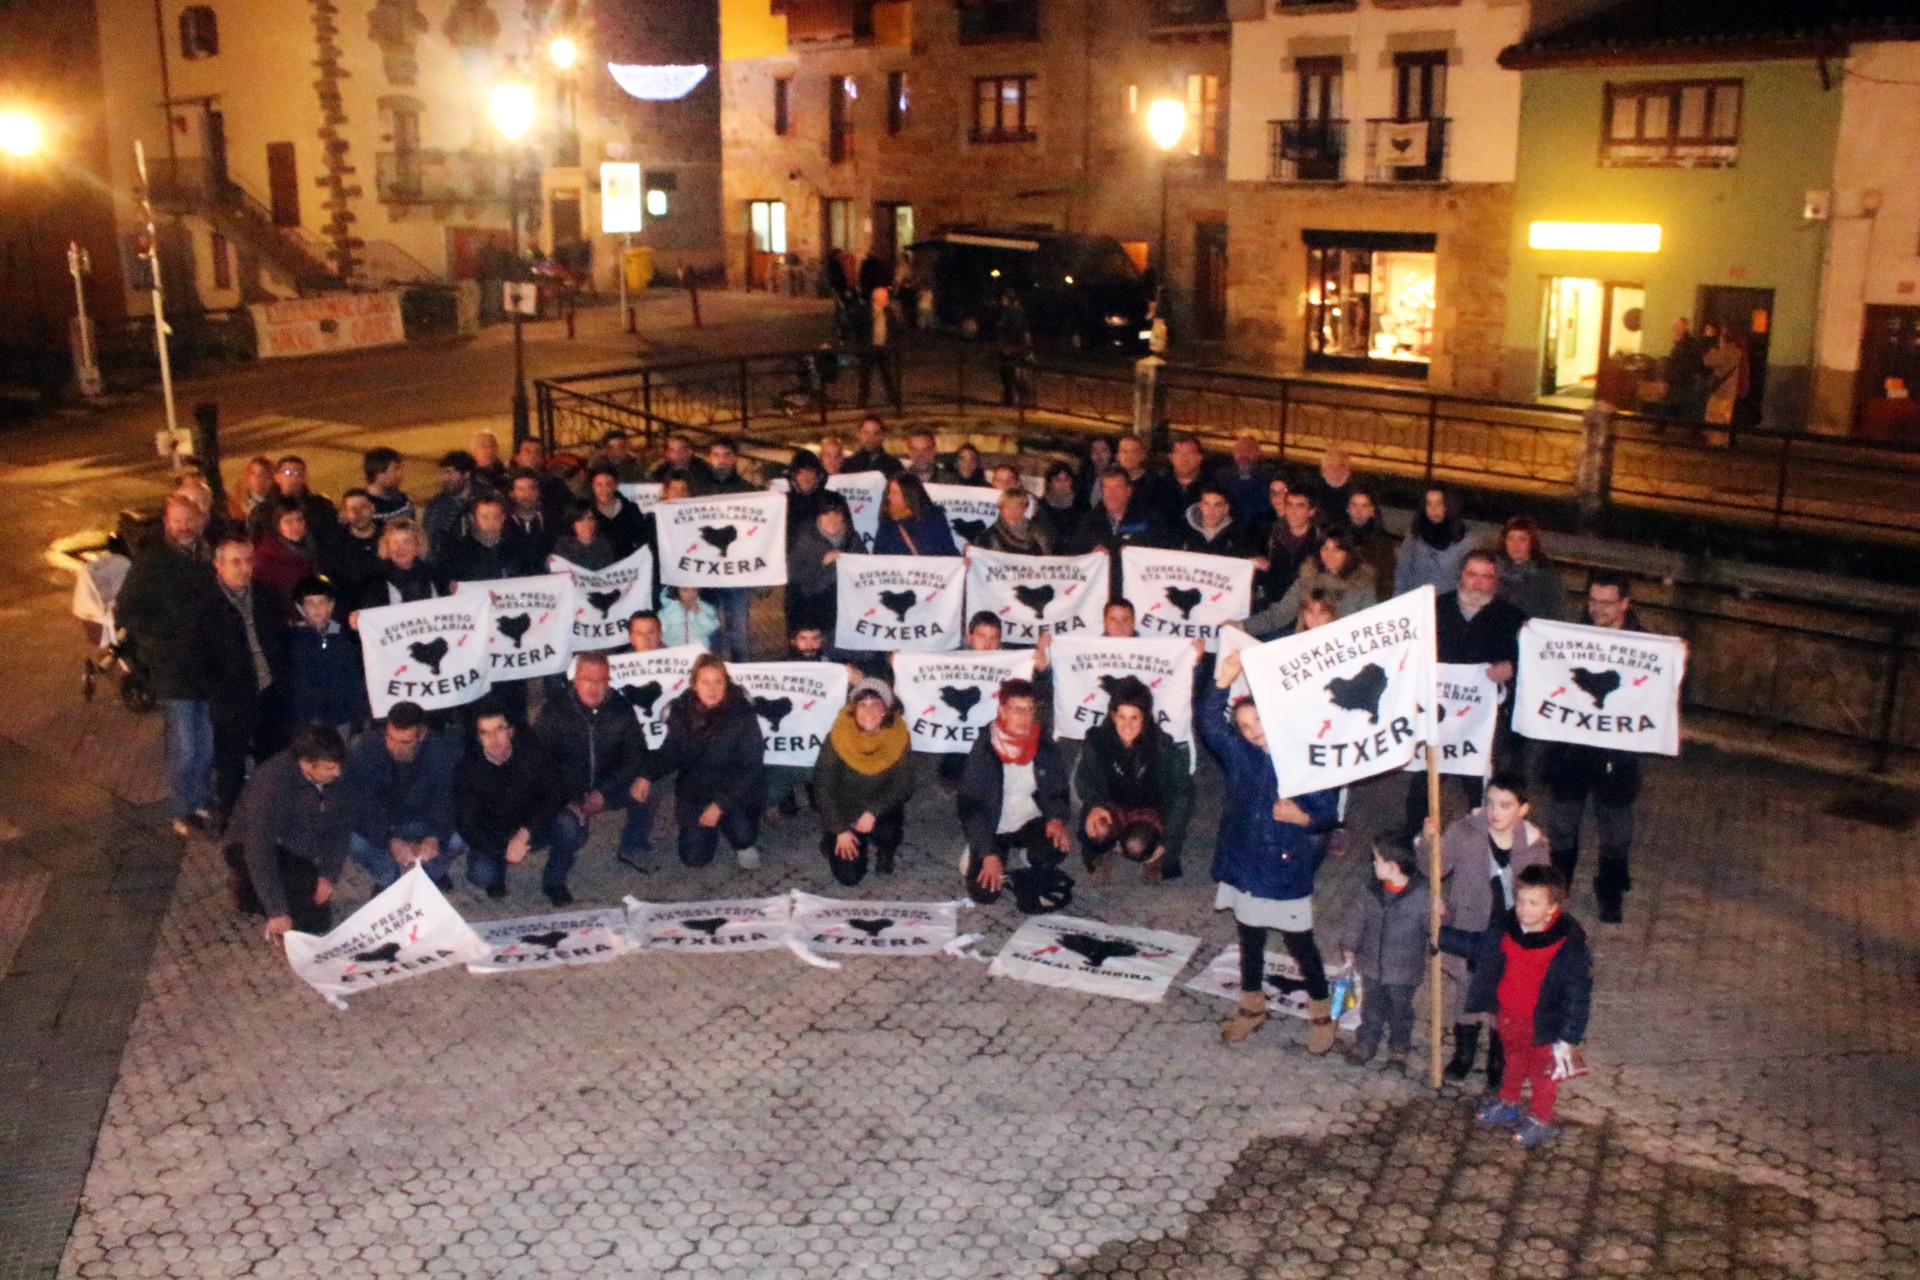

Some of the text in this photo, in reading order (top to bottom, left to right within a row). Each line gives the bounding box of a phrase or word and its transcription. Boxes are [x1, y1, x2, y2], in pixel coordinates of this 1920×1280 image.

[674, 515, 694, 524] ETA
[678, 505, 763, 516] EUSKAL PRESO
[678, 556, 767, 575] ETXERA
[1145, 565, 1230, 583] EUSKAL PRESO
[855, 580, 875, 589] ETA
[859, 570, 943, 582] EUSKAL PRESO
[1140, 573, 1162, 582] ETA
[380, 623, 475, 646] ETA IHESLARIAK
[384, 613, 472, 636] EUSKAL PRESO
[573, 618, 629, 638] ETXER
[855, 619, 943, 640] ETXERA
[1004, 615, 1087, 639] TXERA
[490, 643, 556, 668] TXERA
[1279, 616, 1411, 677] EUSKAL PRESO
[1545, 641, 1659, 662] EUSKAL PRESO
[610, 658, 689, 671] SKAL PRESO
[1071, 661, 1175, 676] ETA IHESLARIAK
[1075, 653, 1170, 667] EUSKAL PRESO
[1539, 651, 1663, 675] ETA IHESLARIAK
[913, 672, 1006, 683] ETA IHESLARIA
[918, 664, 1012, 677] EUSKAL PRESO
[387, 668, 480, 697] ETXERA
[735, 674, 824, 689] USKAL PRESO
[751, 682, 827, 699] IHESLARIAK
[1281, 670, 1313, 692] ETA
[1538, 699, 1656, 733] ETXERA
[912, 718, 976, 741] ETXE
[1308, 716, 1415, 768] ETXER
[370, 902, 412, 931] PRESO
